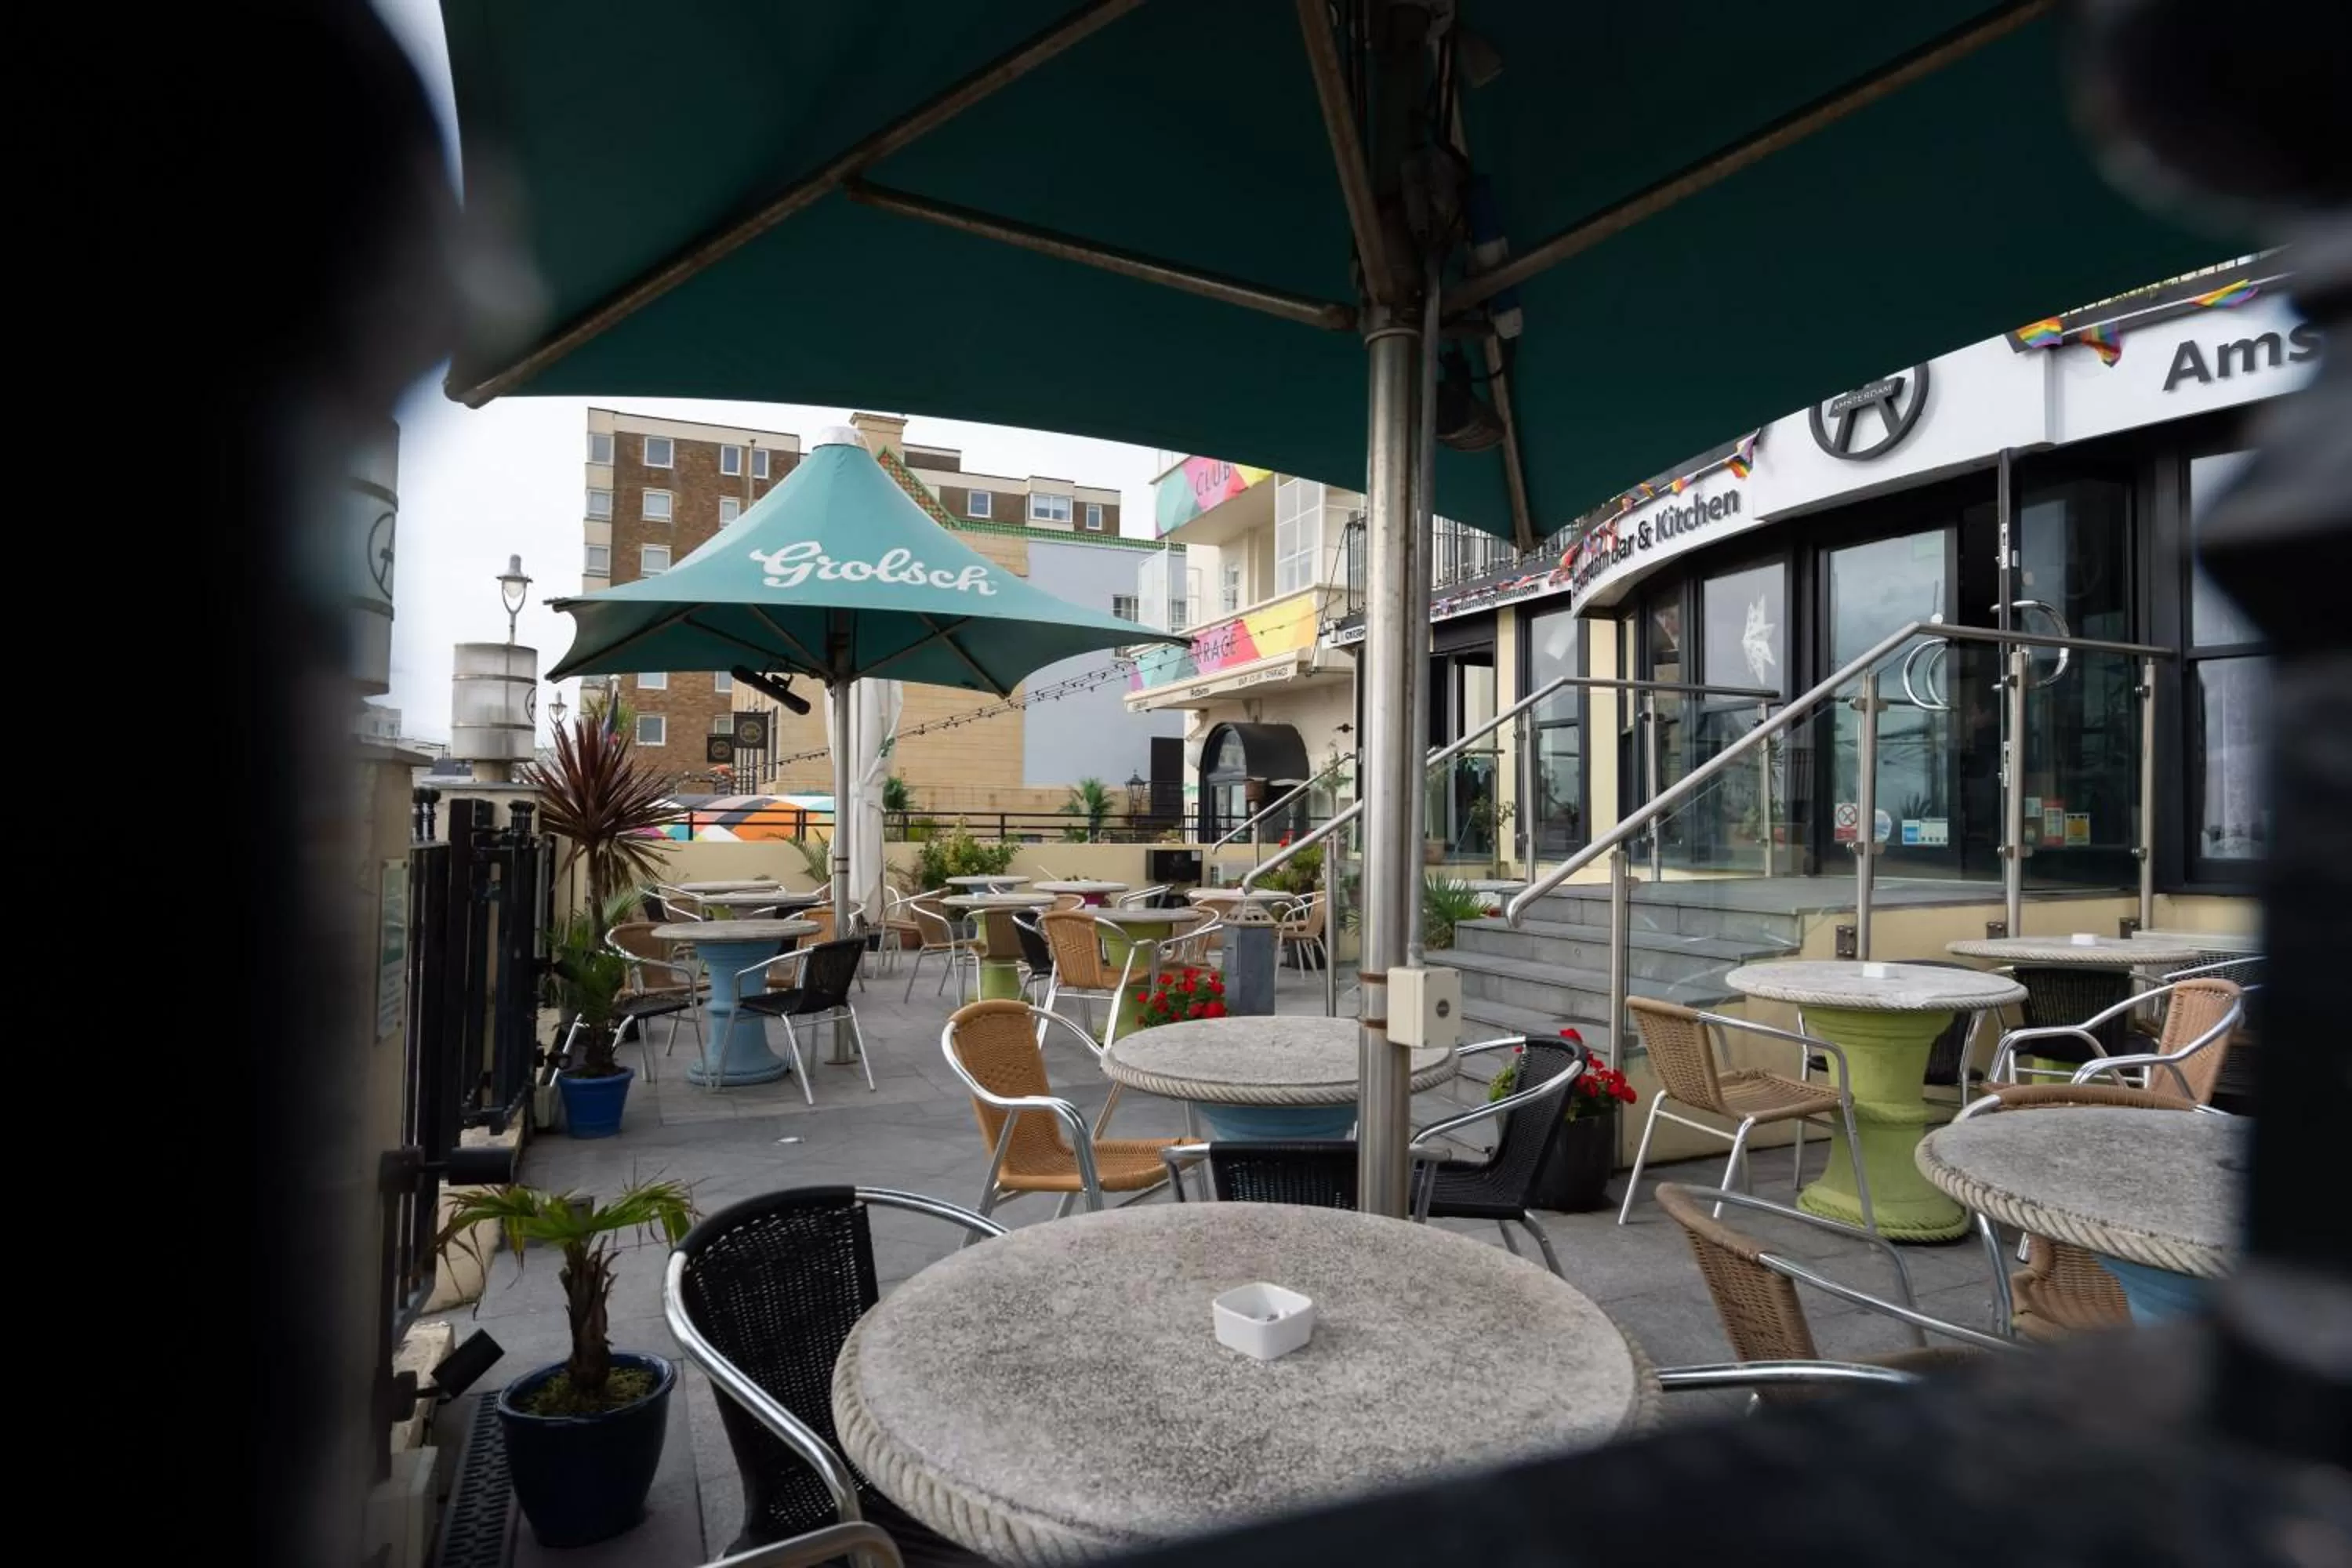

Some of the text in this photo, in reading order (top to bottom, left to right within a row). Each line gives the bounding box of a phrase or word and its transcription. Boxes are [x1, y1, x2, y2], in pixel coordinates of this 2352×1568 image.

[1835, 383, 1892, 409] AMSTERDAM
[1196, 461, 1230, 496] CLUB
[1638, 521, 1651, 550] &
[1656, 489, 1740, 543] Kitchen
[749, 541, 997, 596] Grolsch
